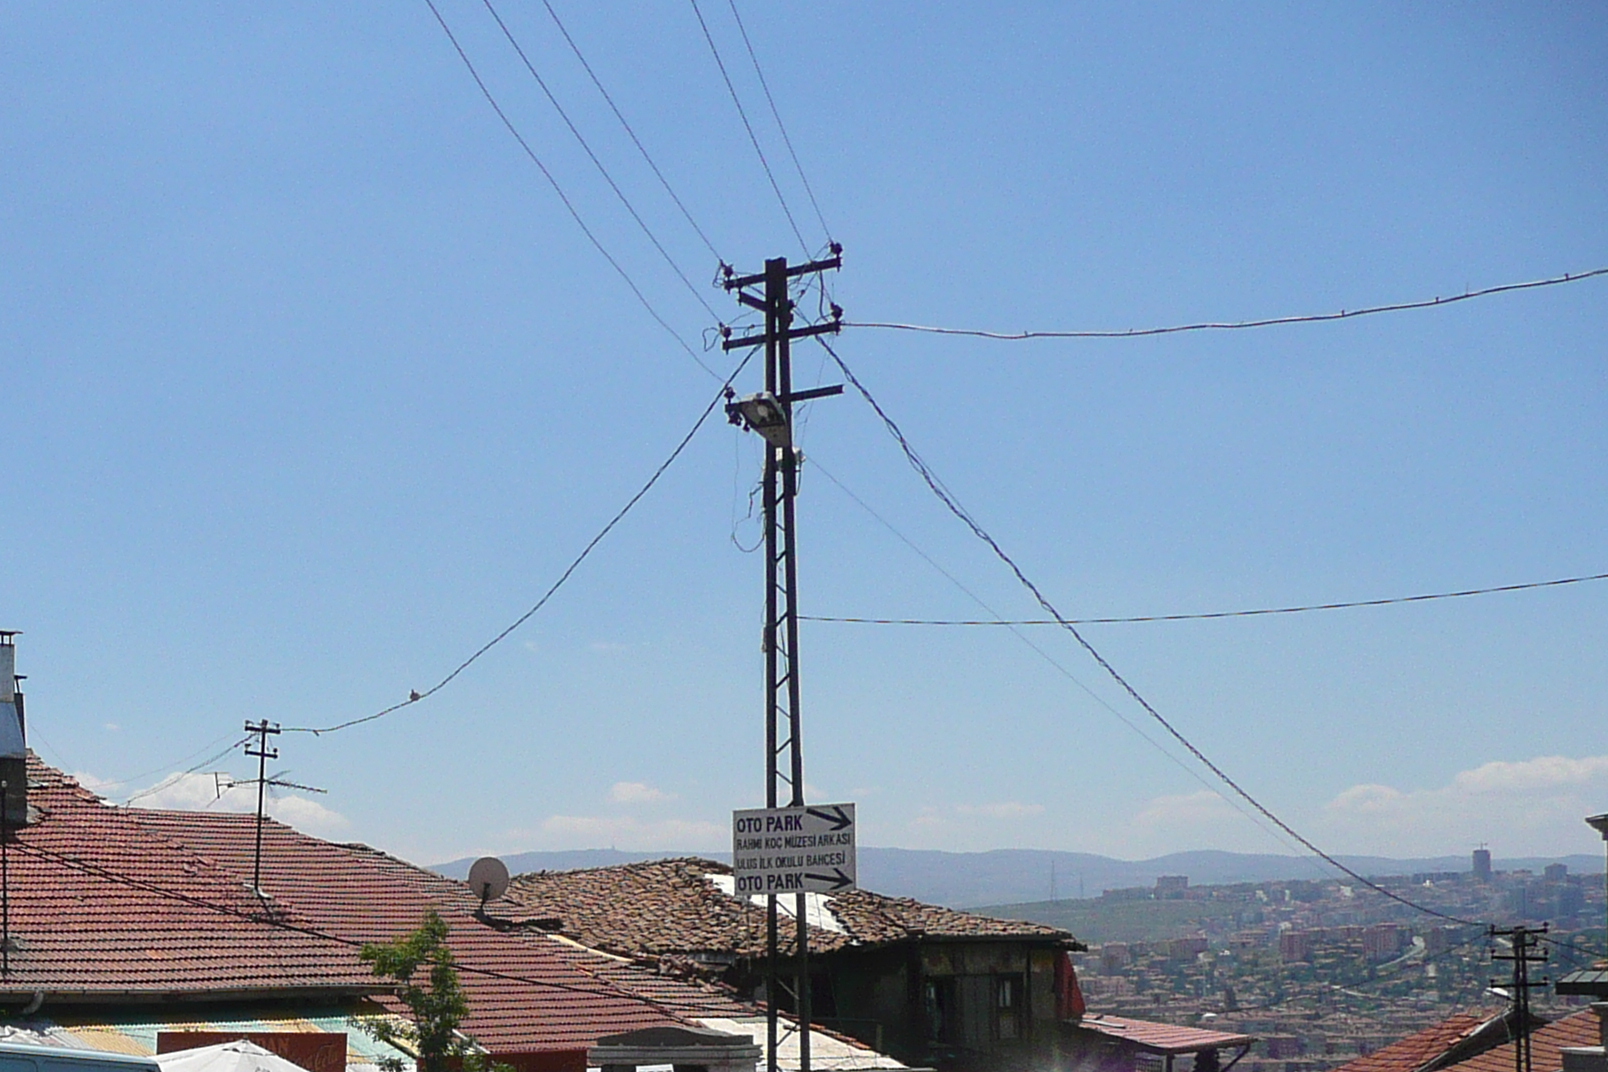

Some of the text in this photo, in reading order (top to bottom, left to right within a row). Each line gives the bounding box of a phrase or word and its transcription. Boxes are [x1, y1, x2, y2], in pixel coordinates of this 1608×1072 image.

[736, 814, 804, 834] OTO PARK
[736, 857, 758, 870] ULUS
[775, 855, 804, 868] OKULU
[737, 873, 804, 892] OTO PARK
